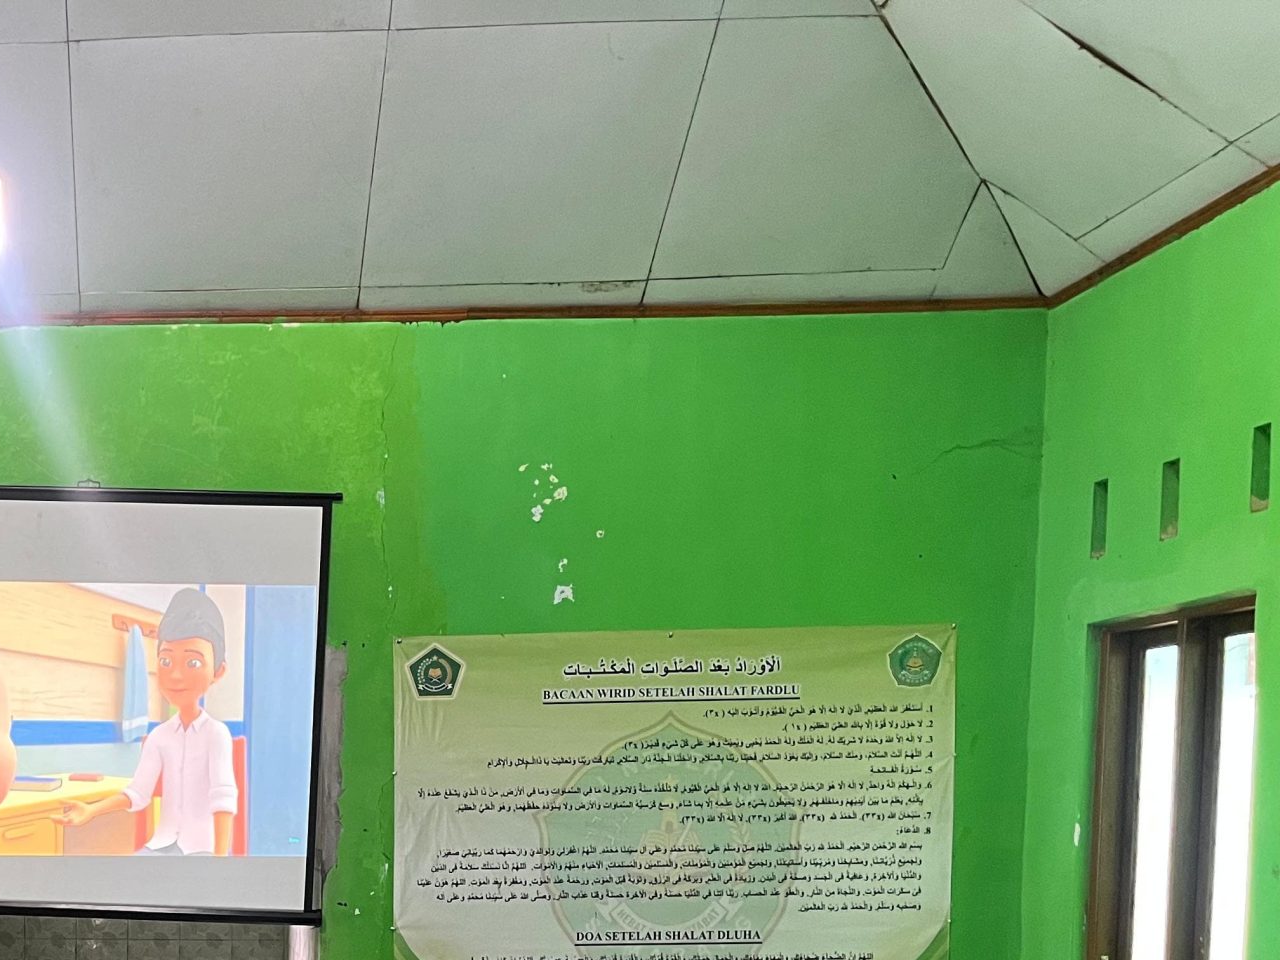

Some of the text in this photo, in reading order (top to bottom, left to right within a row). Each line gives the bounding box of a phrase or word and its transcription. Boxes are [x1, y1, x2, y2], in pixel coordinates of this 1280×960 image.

[543, 685, 799, 700] BACAAN WIRID SETELAH SHALAT FARDLU
[576, 930, 761, 942] DOA SETELAH SHALAT DLUHA
